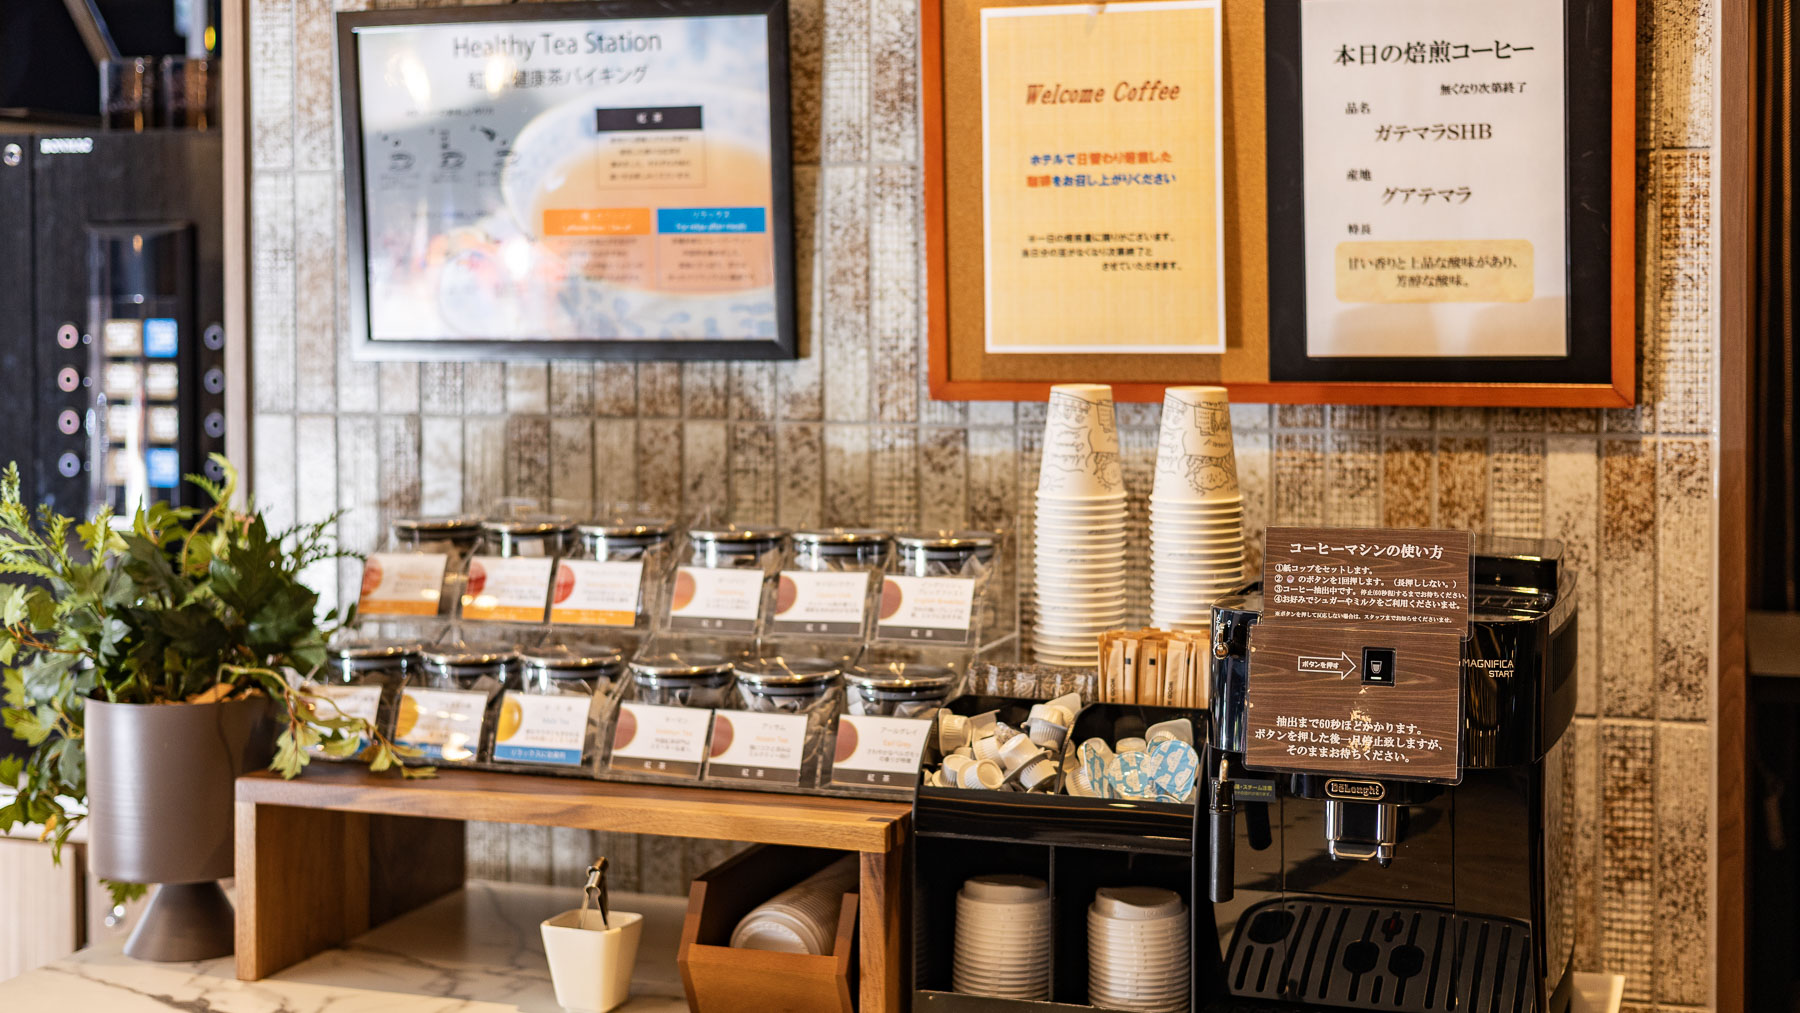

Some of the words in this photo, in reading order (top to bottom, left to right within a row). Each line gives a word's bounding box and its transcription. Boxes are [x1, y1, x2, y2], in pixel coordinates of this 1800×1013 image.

[452, 35, 536, 62] Healthy
[540, 32, 578, 55] Tea
[584, 30, 663, 55] Station
[1334, 40, 1535, 66] 本日の焙煎コーヒー
[469, 65, 648, 90] 紅健康茶バイキング
[1025, 83, 1106, 105] Welcome
[1113, 79, 1181, 103] Coffee
[1440, 81, 1528, 96] 無くなり次第終了
[1345, 102, 1371, 115] 品名
[1375, 123, 1493, 142] ガテマラSHB
[1346, 168, 1372, 182] 産地
[1381, 186, 1473, 205] グアテマラ
[1290, 542, 1444, 559] コーヒーマシンの使い方
[1302, 660, 1339, 669] ボタンを押す
[1462, 658, 1514, 669] MAGNIFICA
[1488, 670, 1514, 678] START
[1276, 716, 1423, 735] 抽出まで60秒ほどかかります。
[1255, 729, 1444, 750] ボタンを押した後一旦停止致しますが、
[1286, 745, 1411, 763] そのままお待ちください。
